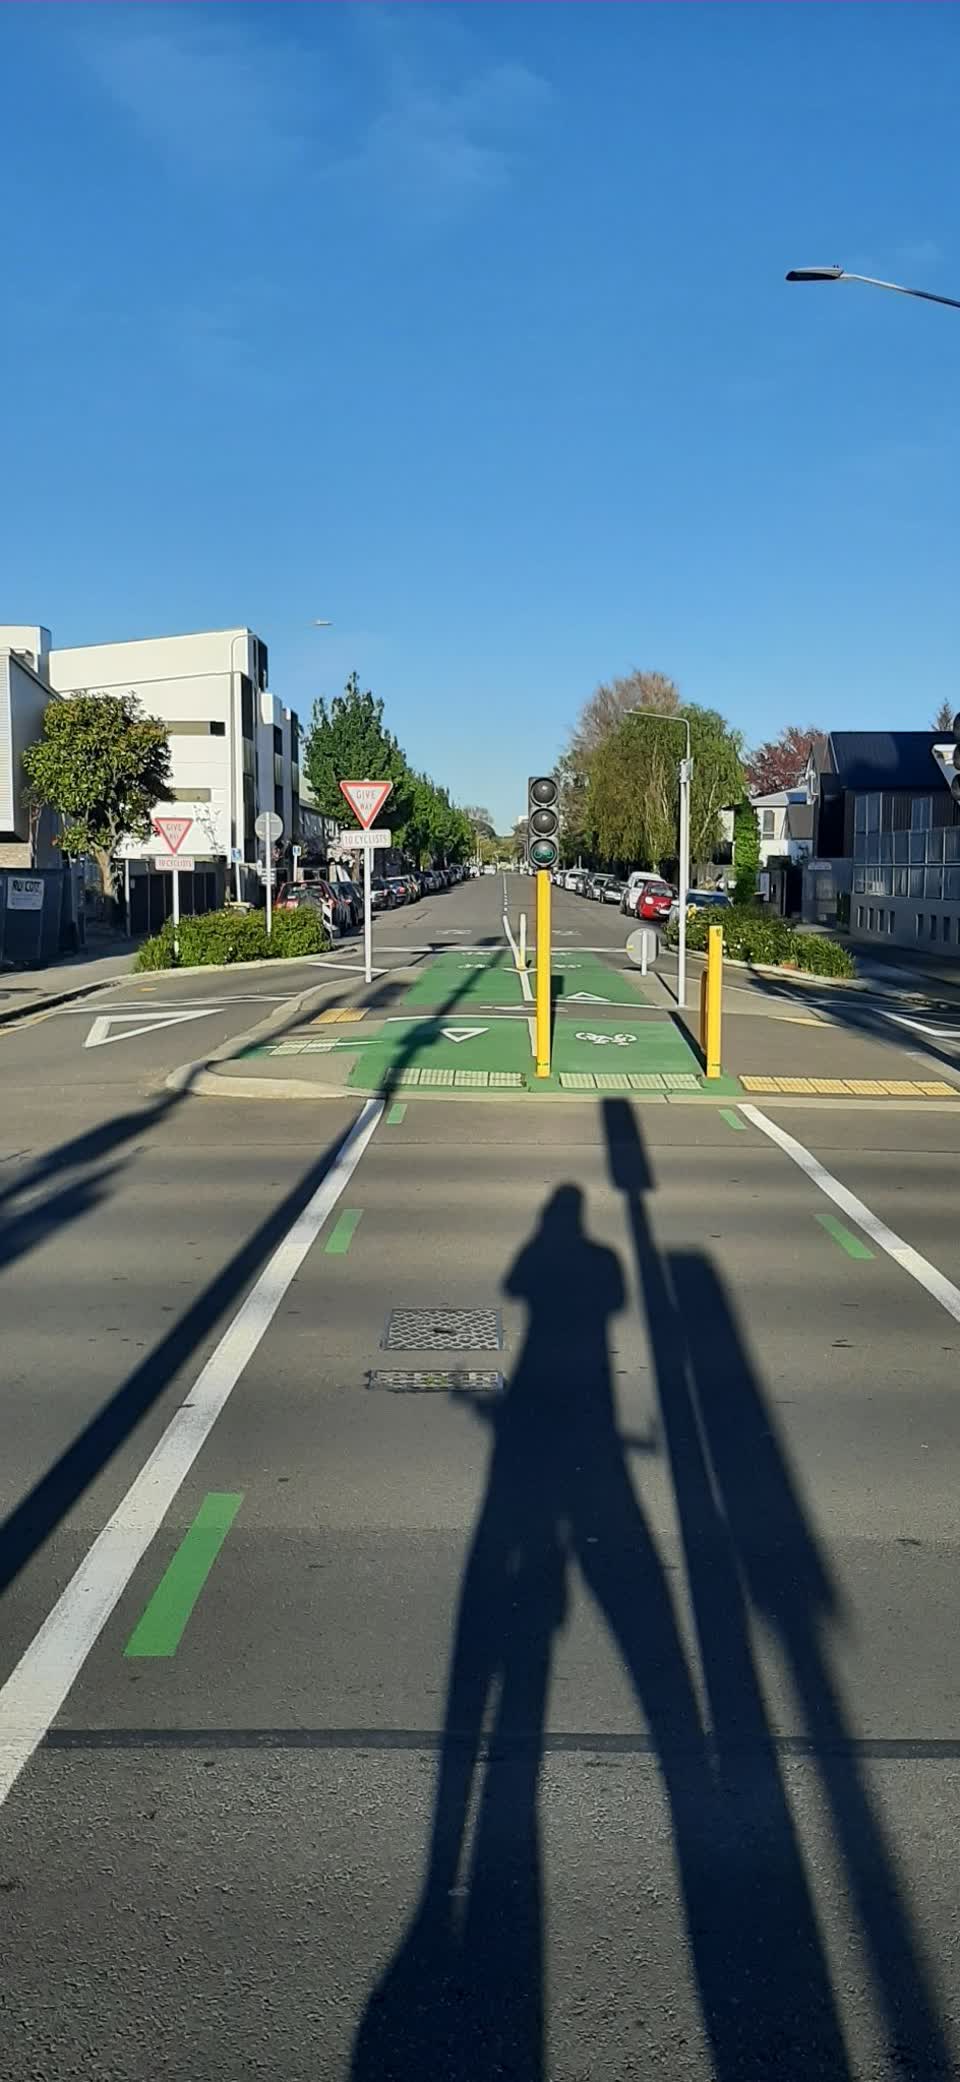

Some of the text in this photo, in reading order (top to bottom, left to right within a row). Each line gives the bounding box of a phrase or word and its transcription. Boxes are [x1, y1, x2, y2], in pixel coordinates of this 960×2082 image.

[356, 790, 375, 799] GIVE
[166, 823, 181, 831] GIVE
[354, 833, 386, 845] CYCLISTS
